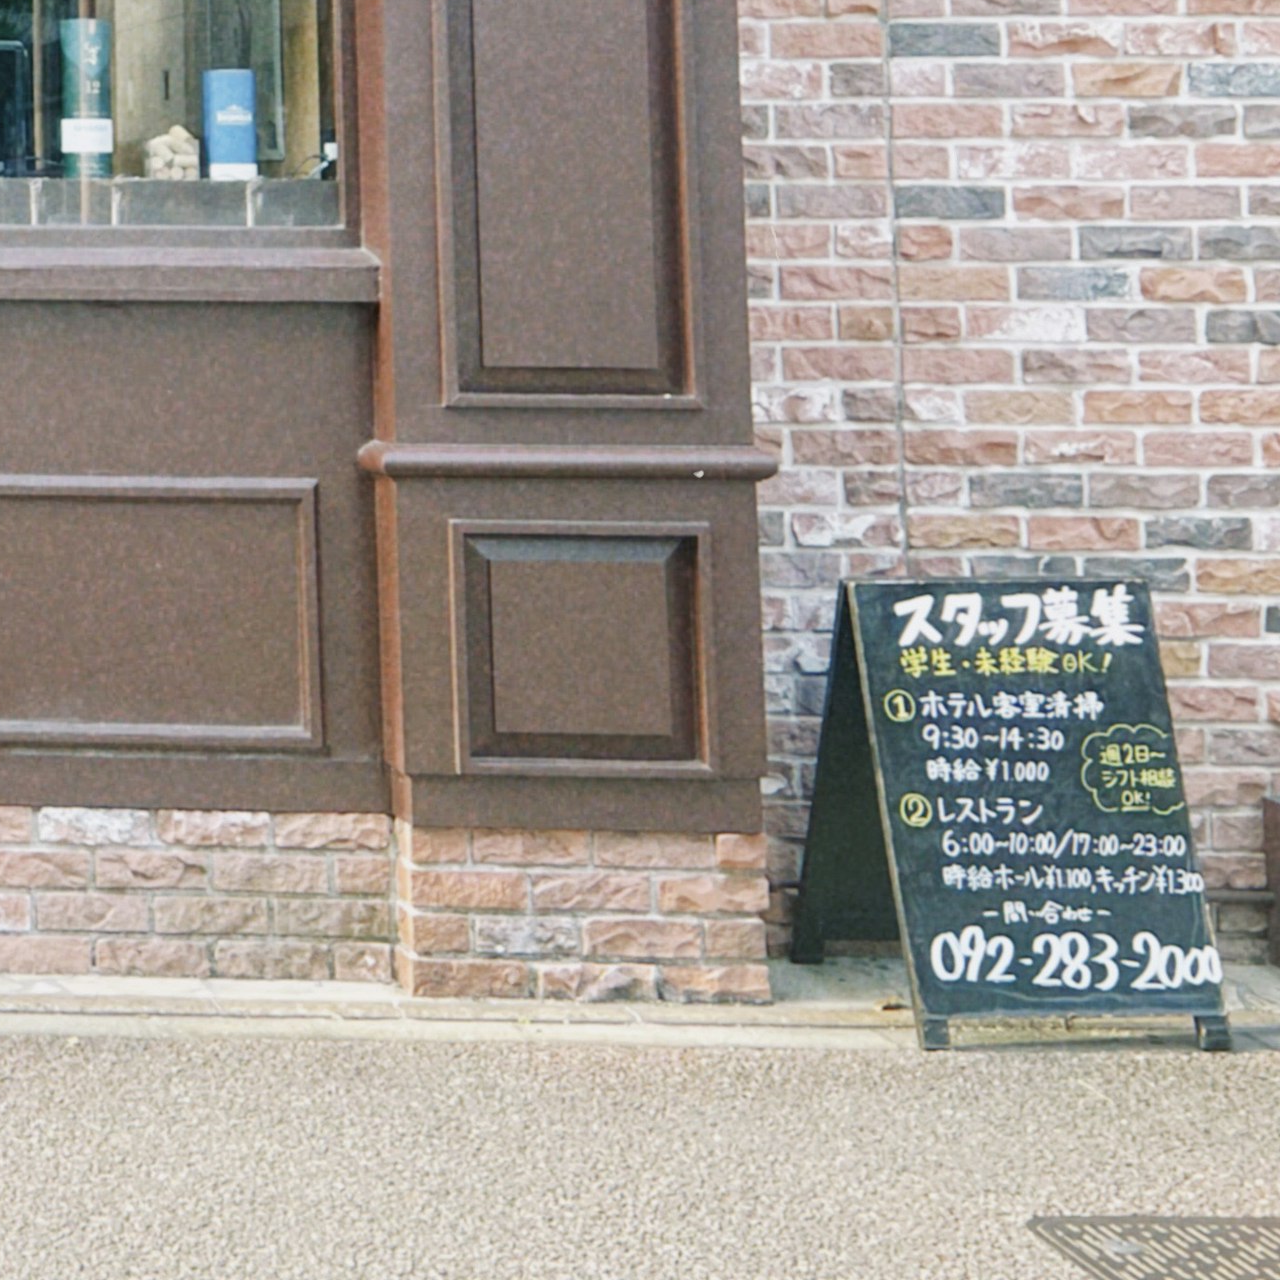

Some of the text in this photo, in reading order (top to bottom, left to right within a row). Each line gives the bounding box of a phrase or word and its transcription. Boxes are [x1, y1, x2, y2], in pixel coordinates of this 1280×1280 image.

[894, 584, 1145, 646] スタッフ募集
[937, 797, 1043, 824] レストラン
[930, 925, 1223, 990] 092-283-2000
